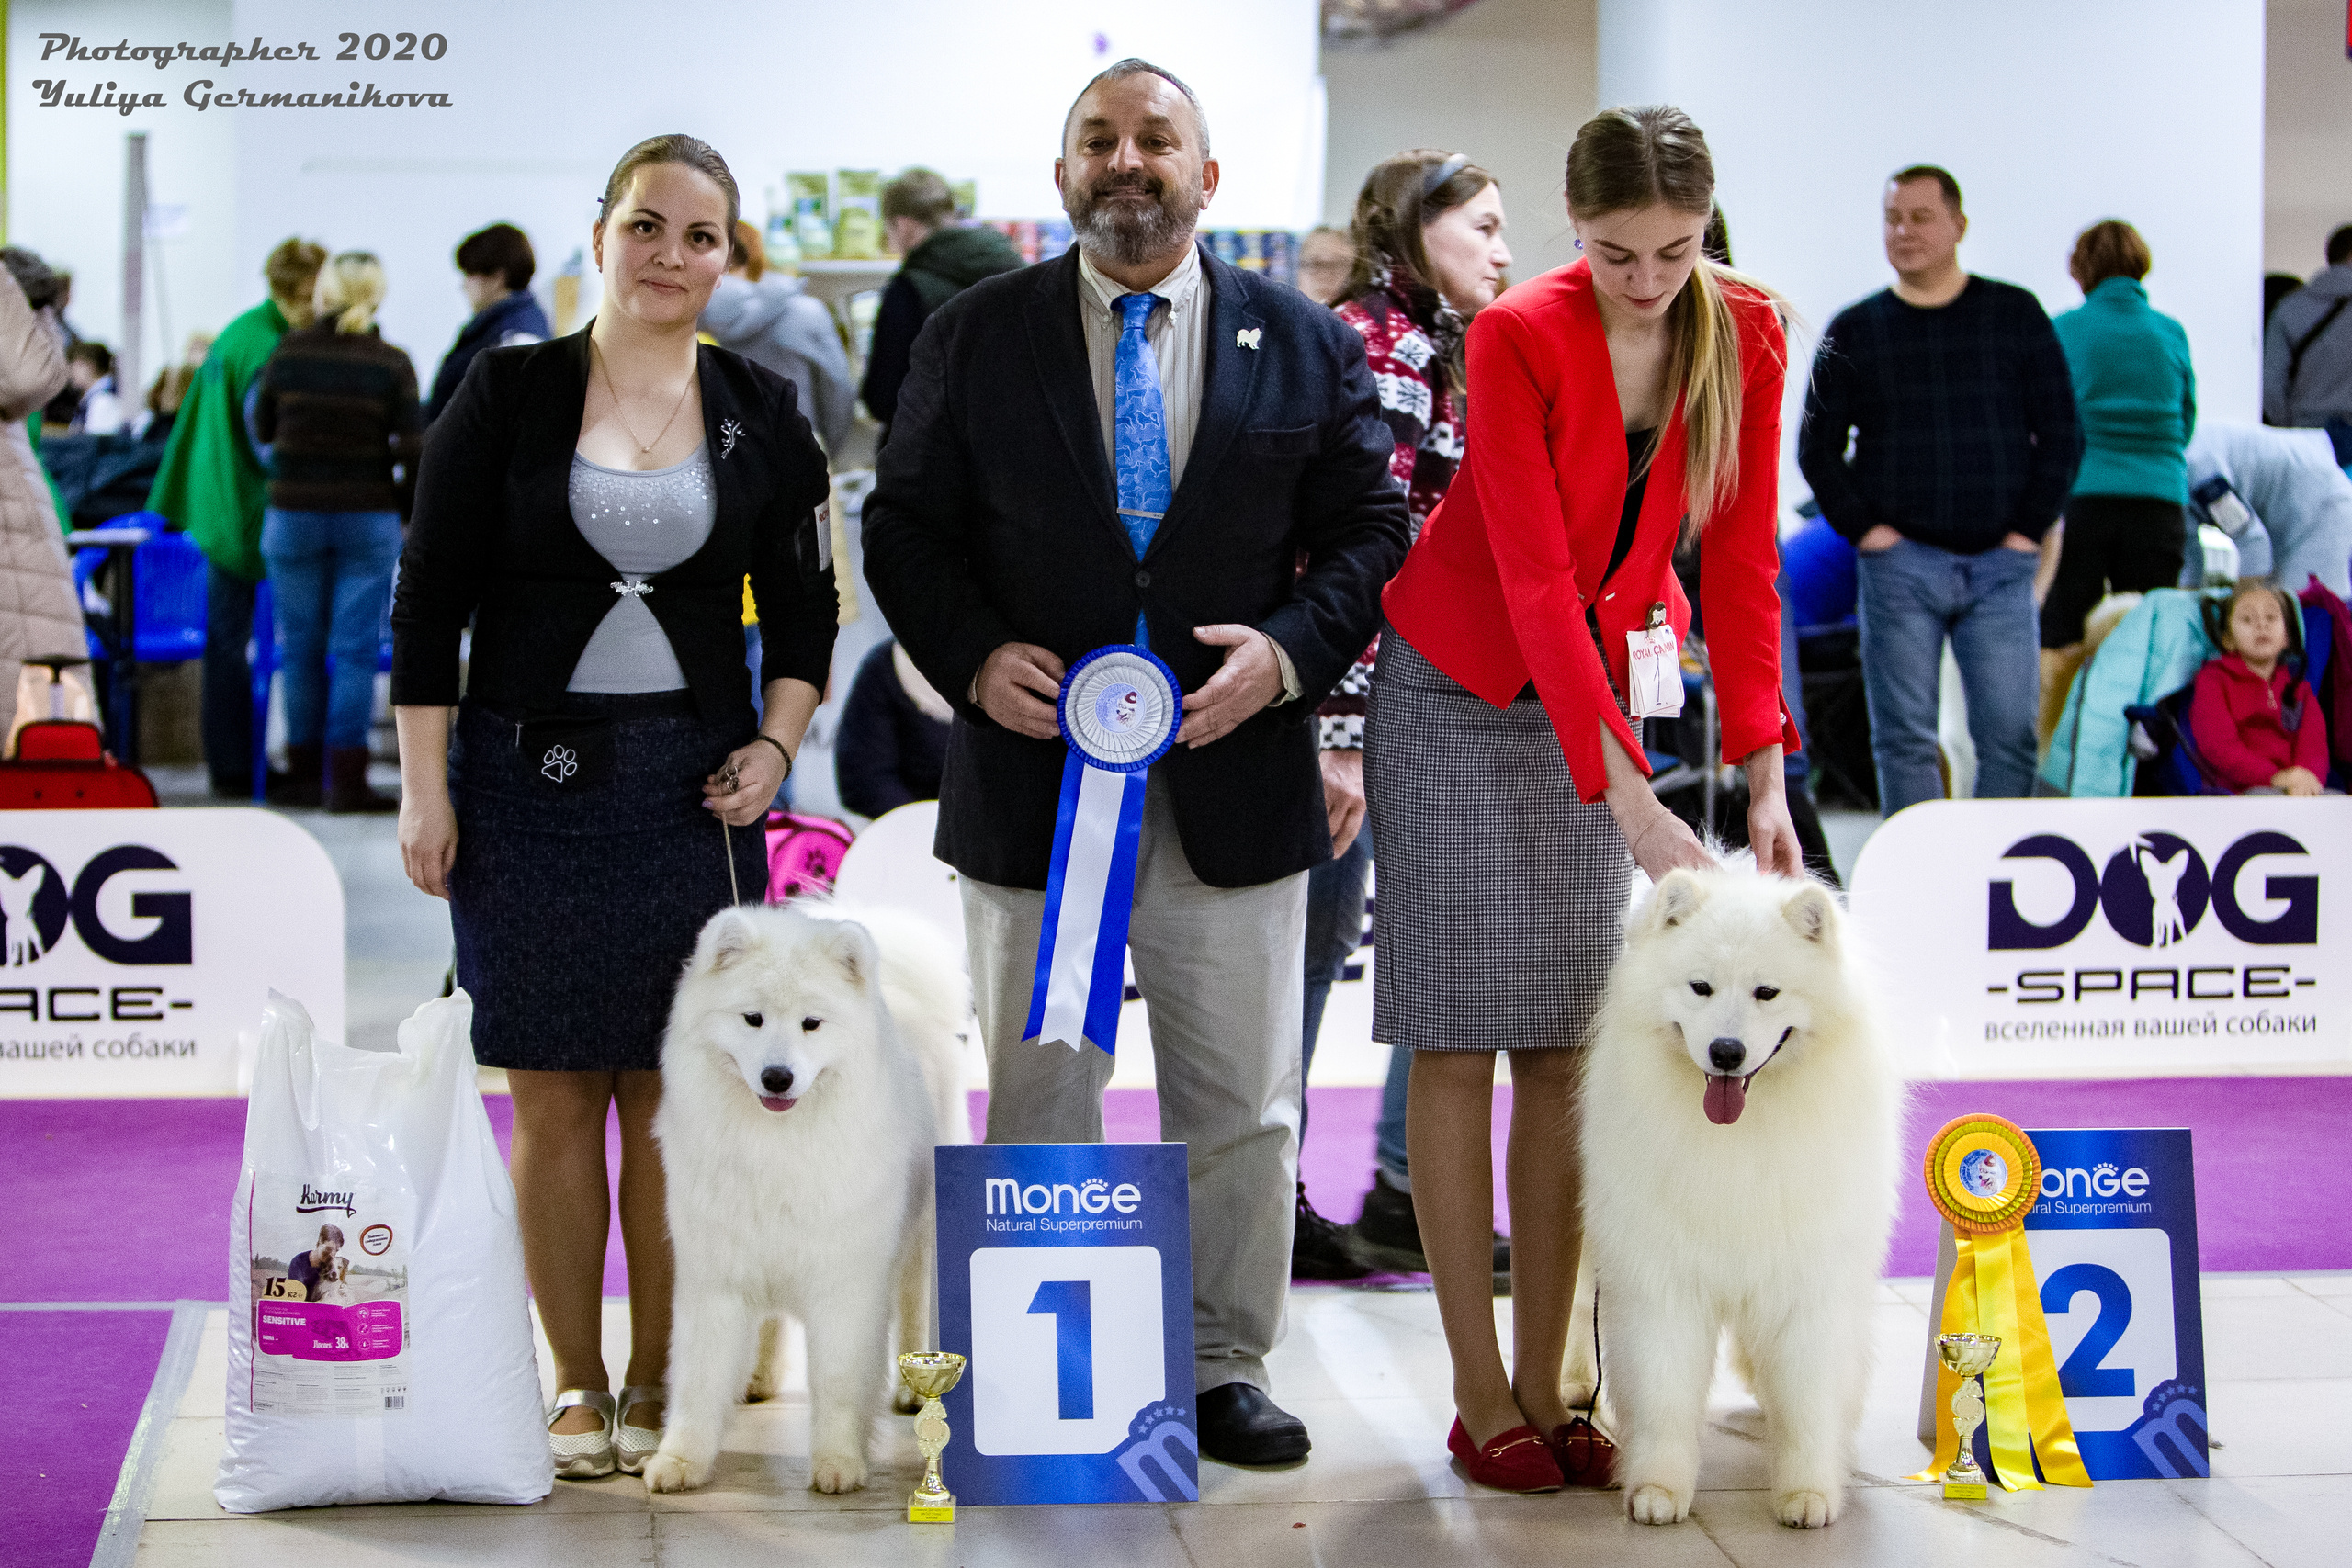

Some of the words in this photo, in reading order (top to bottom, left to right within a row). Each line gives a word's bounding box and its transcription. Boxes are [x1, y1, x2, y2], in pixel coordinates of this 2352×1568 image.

[1632, 647, 1652, 661] ROYAL
[1653, 641, 1675, 657] CANIN
[0, 844, 192, 966] OG
[1987, 830, 2320, 952] DOG
[0, 987, 193, 1021] ACE-
[1985, 1018, 2125, 1043] вселенная
[2133, 1010, 2218, 1037] вашей
[2226, 1008, 2317, 1034] собаки
[0, 1033, 83, 1059] ашей
[92, 1031, 196, 1058] собаки
[297, 1183, 357, 1218] Karmy
[2028, 1201, 2051, 1214] ural
[2054, 1201, 2152, 1216] Superpremium
[986, 1218, 1036, 1232] Natural
[1040, 1217, 1143, 1234] Superpremium
[263, 1276, 286, 1298] 15
[262, 1314, 307, 1327] SENSITIVE
[2040, 1263, 2136, 1398] 2
[1026, 1280, 1094, 1420] 1
